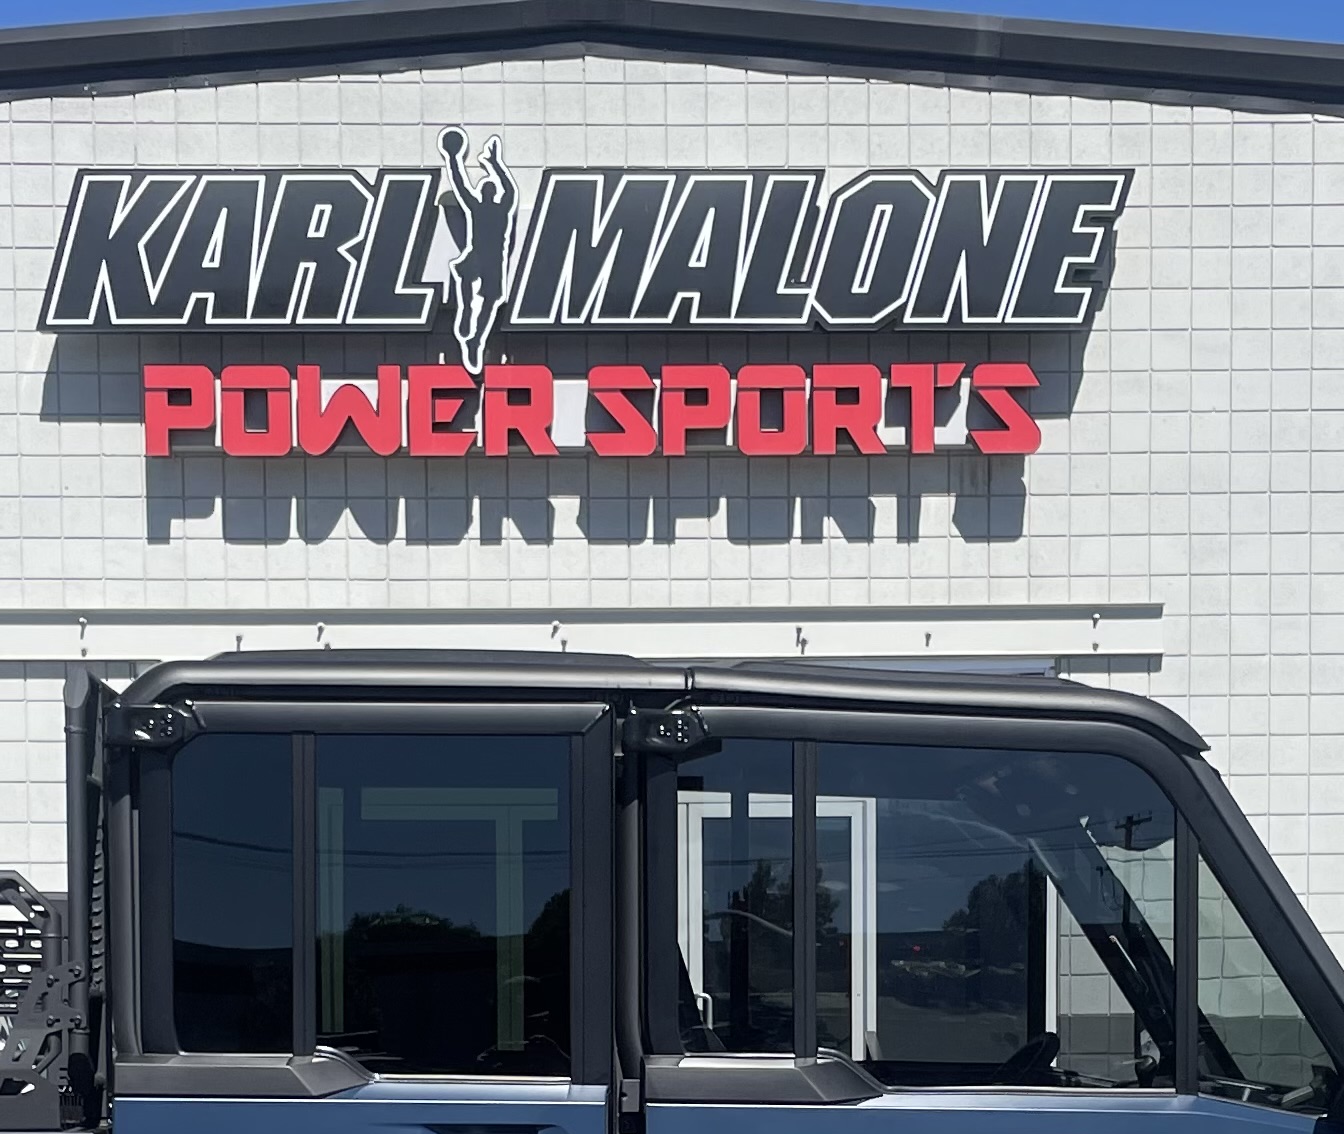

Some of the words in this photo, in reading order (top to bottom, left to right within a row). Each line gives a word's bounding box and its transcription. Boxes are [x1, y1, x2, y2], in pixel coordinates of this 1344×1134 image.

[43, 172, 436, 328] KARL
[509, 172, 1128, 326] MALONE
[143, 363, 560, 458] POWER
[584, 362, 1043, 458] SPORTS
